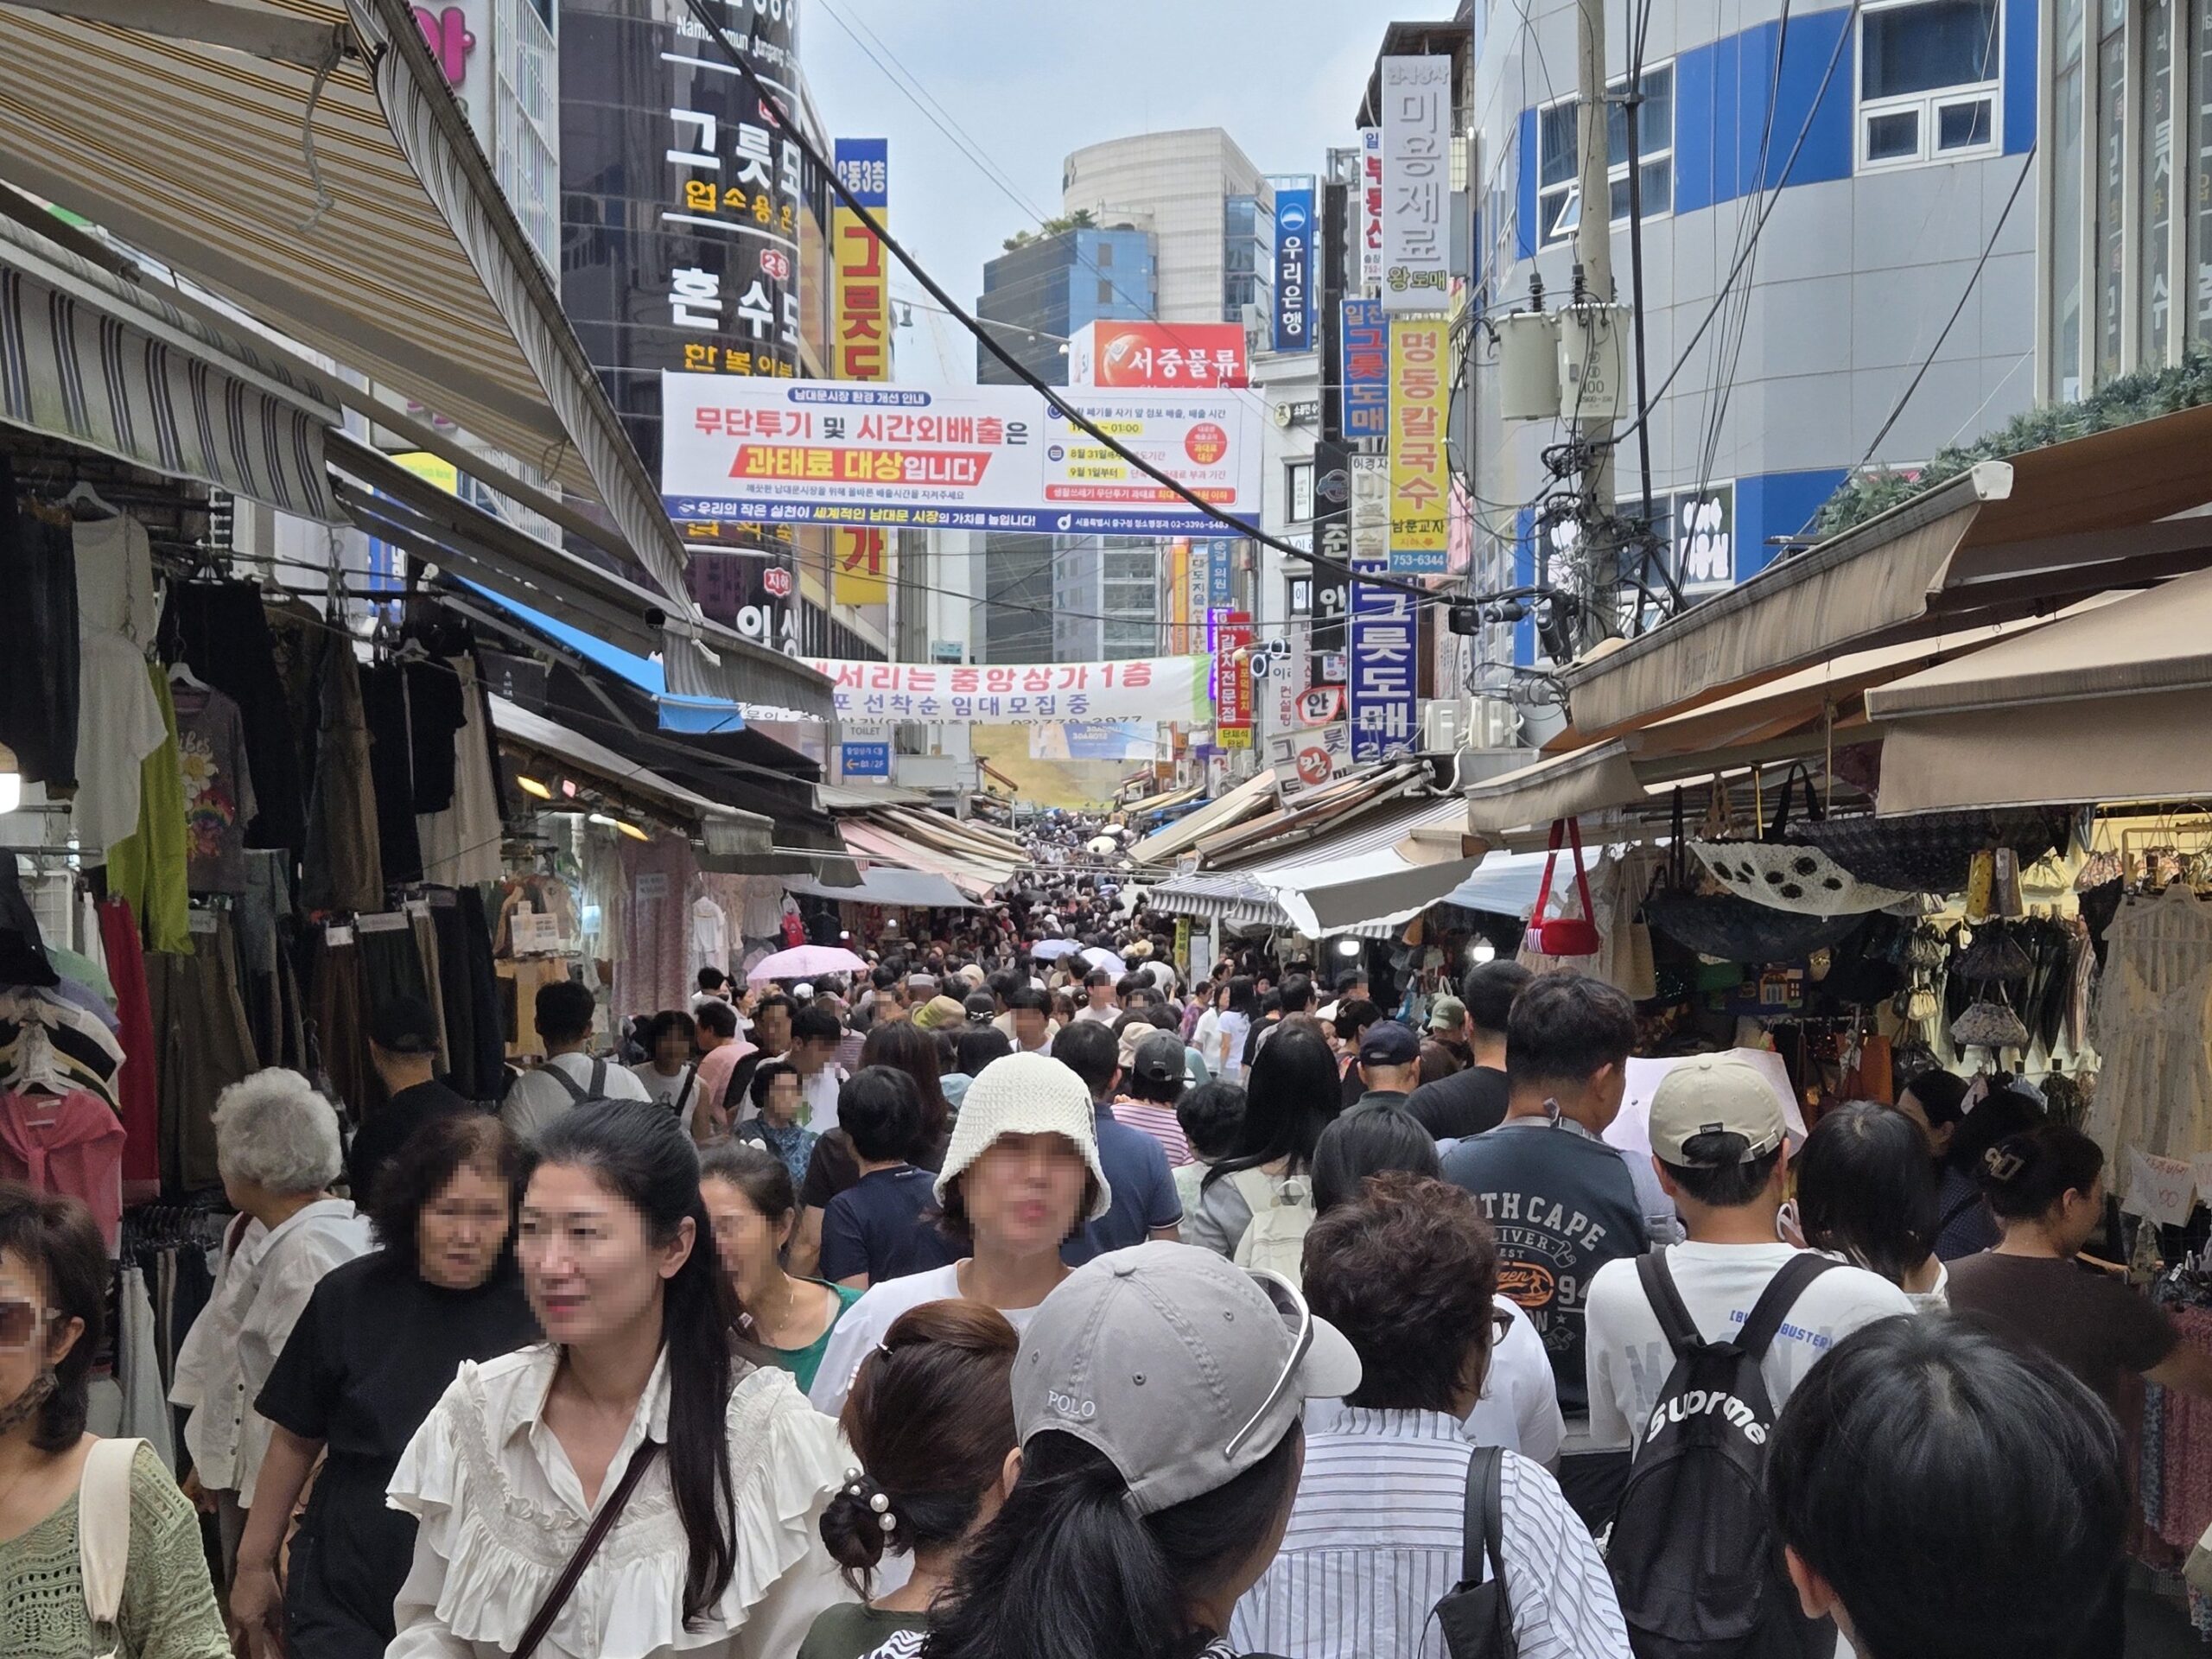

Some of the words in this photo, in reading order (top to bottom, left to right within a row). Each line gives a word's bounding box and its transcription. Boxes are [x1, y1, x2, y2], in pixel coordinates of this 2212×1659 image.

[1281, 236, 1304, 335] 우리은행
[1128, 347, 1240, 378] 서중물류
[901, 392, 925, 404] 안내
[695, 407, 811, 439] 무단투기
[823, 416, 845, 439] 및
[857, 415, 1028, 445] 시간외배출은
[1396, 331, 1440, 511] 명동칼국수
[746, 447, 835, 477] 과태료
[844, 450, 976, 481] 대상입니다
[697, 501, 736, 515] 우리의
[741, 503, 766, 516] 작은
[771, 505, 810, 518] 실천이
[813, 506, 866, 520] 세계적인
[869, 508, 909, 522] 남대문
[912, 510, 950, 524] 시장의
[1393, 555, 1445, 566] 753-6344
[950, 664, 1088, 693] 중앙상가
[1220, 633, 1236, 722] 갈치전문점
[1357, 594, 1412, 738] 그릇도매
[864, 693, 941, 715] 선착순
[1066, 693, 1090, 715] 중
[850, 727, 880, 735] TOILET
[1047, 1389, 1096, 1417] POLO
